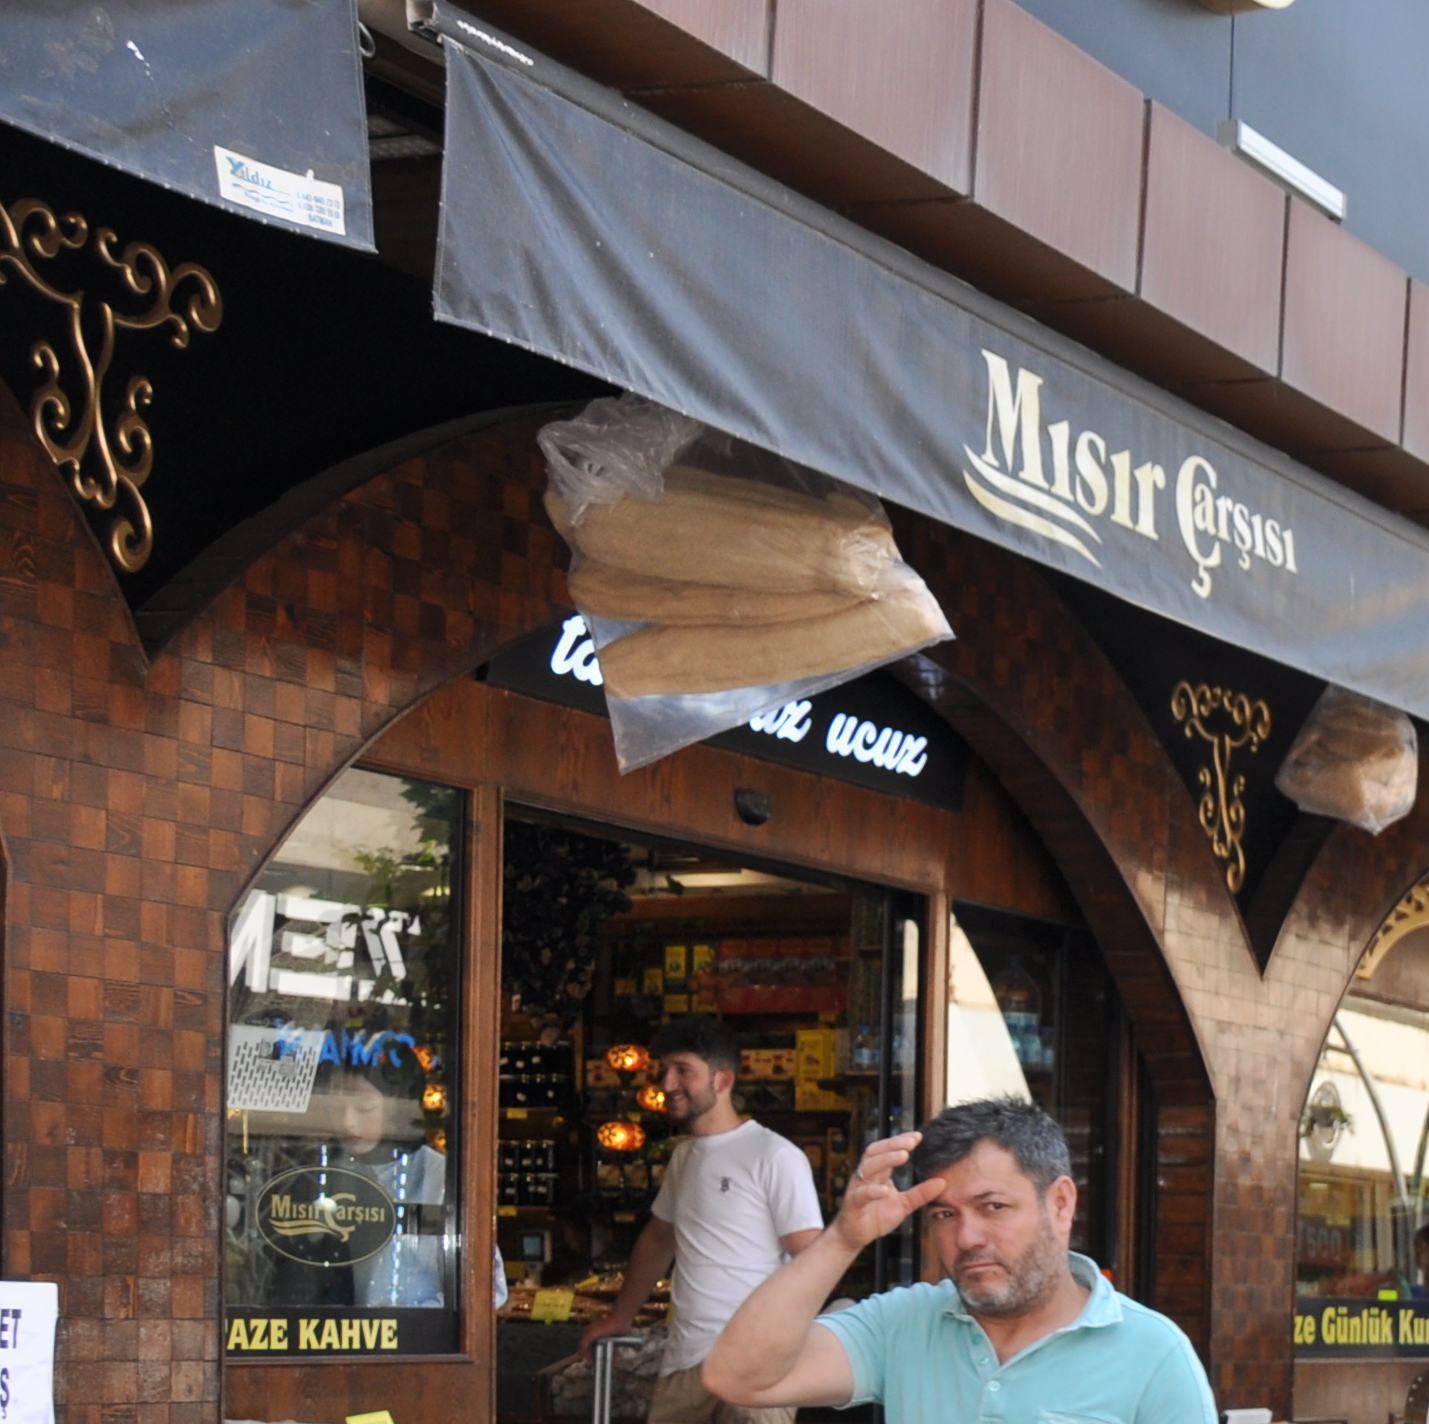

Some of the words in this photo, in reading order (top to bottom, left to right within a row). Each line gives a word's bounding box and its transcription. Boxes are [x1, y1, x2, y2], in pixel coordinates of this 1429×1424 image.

[825, 713, 928, 777] ucuz
[225, 1318, 289, 1351] AZE
[299, 1318, 398, 1351] KAHVE
[1321, 1305, 1394, 1346] Günlük
